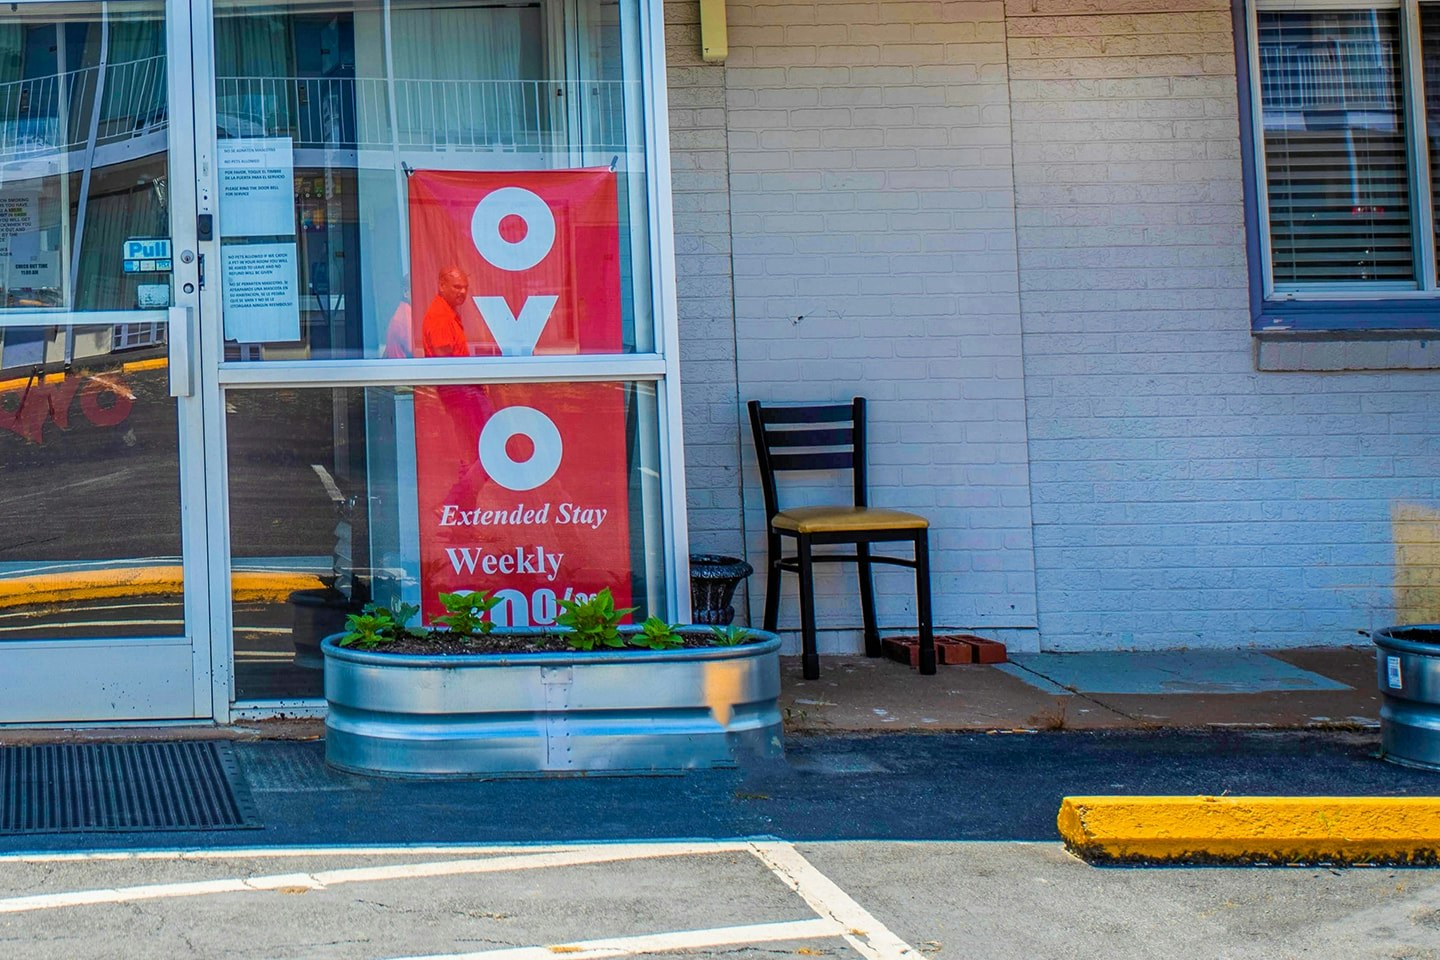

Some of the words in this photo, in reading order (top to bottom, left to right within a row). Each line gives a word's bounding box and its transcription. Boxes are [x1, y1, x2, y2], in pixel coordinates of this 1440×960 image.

[129, 242, 166, 257] Pull
[439, 503, 550, 527] Extended
[555, 502, 608, 529] Stay
[445, 546, 565, 581] Weekly
